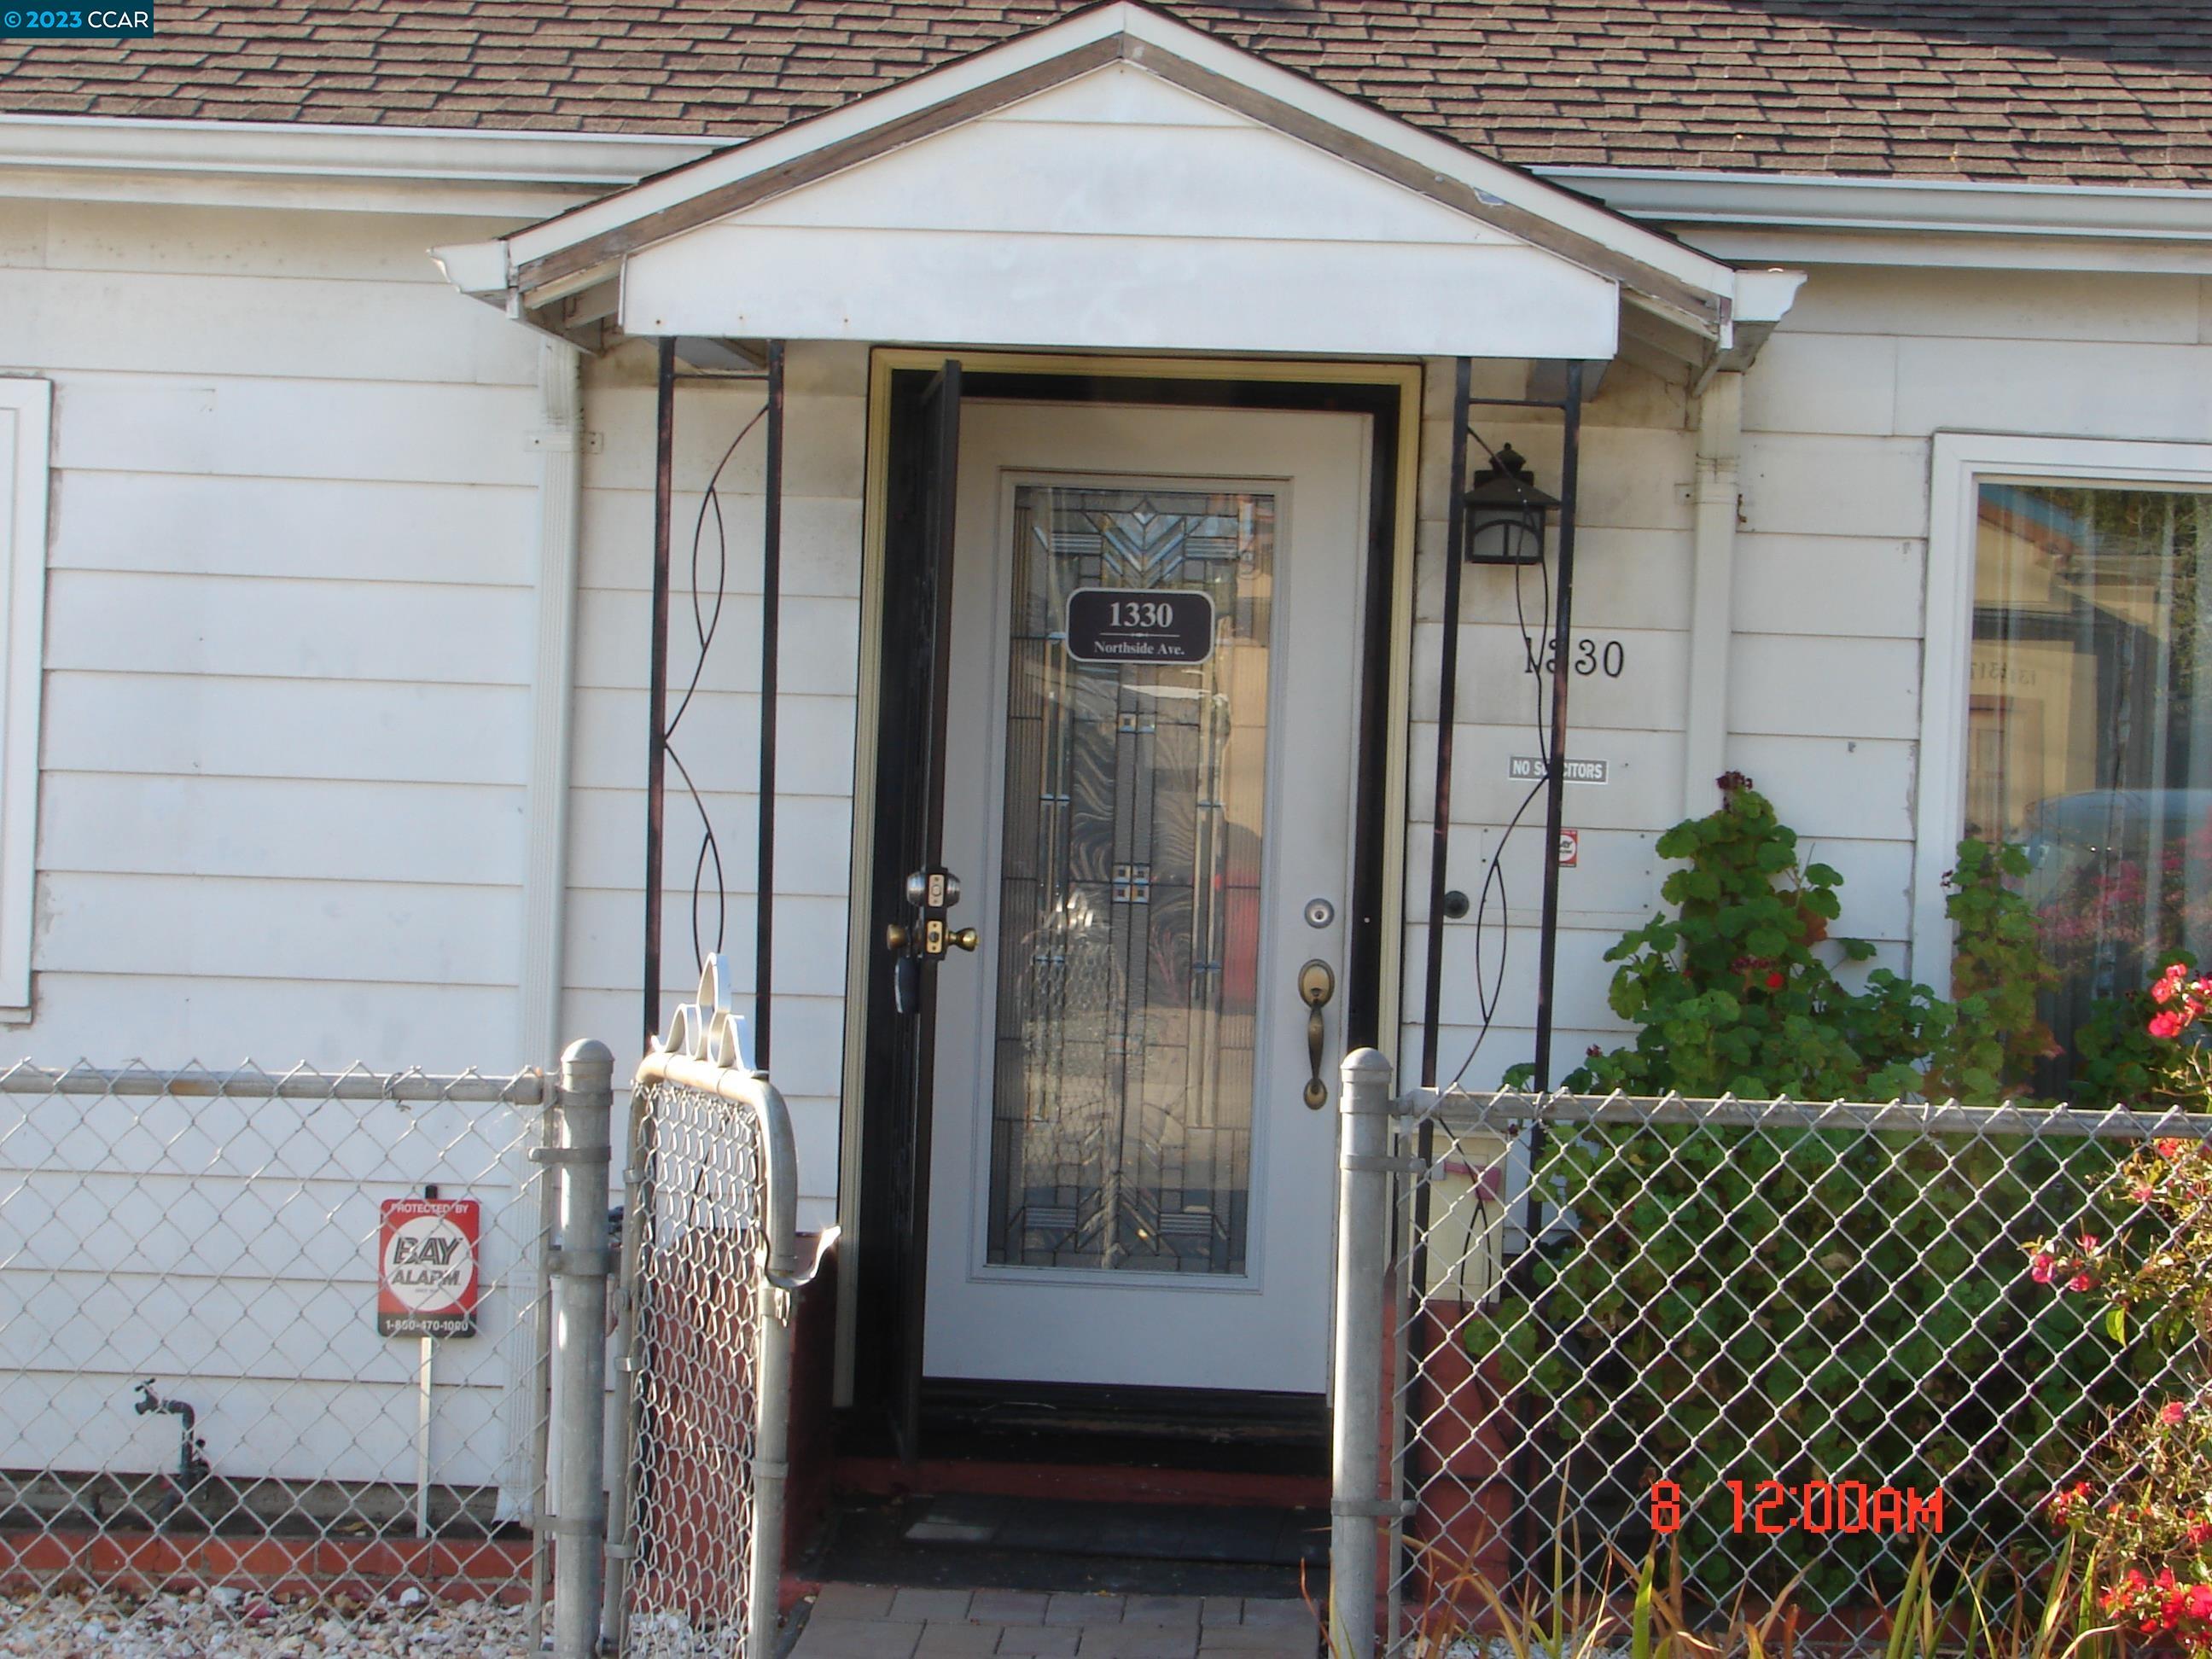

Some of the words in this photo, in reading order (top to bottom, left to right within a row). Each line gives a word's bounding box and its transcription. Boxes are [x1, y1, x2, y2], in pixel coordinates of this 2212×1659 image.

[1110, 602, 1173, 628] 1330
[1094, 641, 1155, 655] Northside
[1157, 643, 1185, 655] Ave.
[1512, 760, 1530, 776] NO
[1534, 761, 1603, 779] SOCITORS
[391, 1203, 450, 1214] PROTECTED
[455, 1204, 469, 1214] BY
[393, 1237, 463, 1266] BAY
[392, 1269, 461, 1286] ALARM
